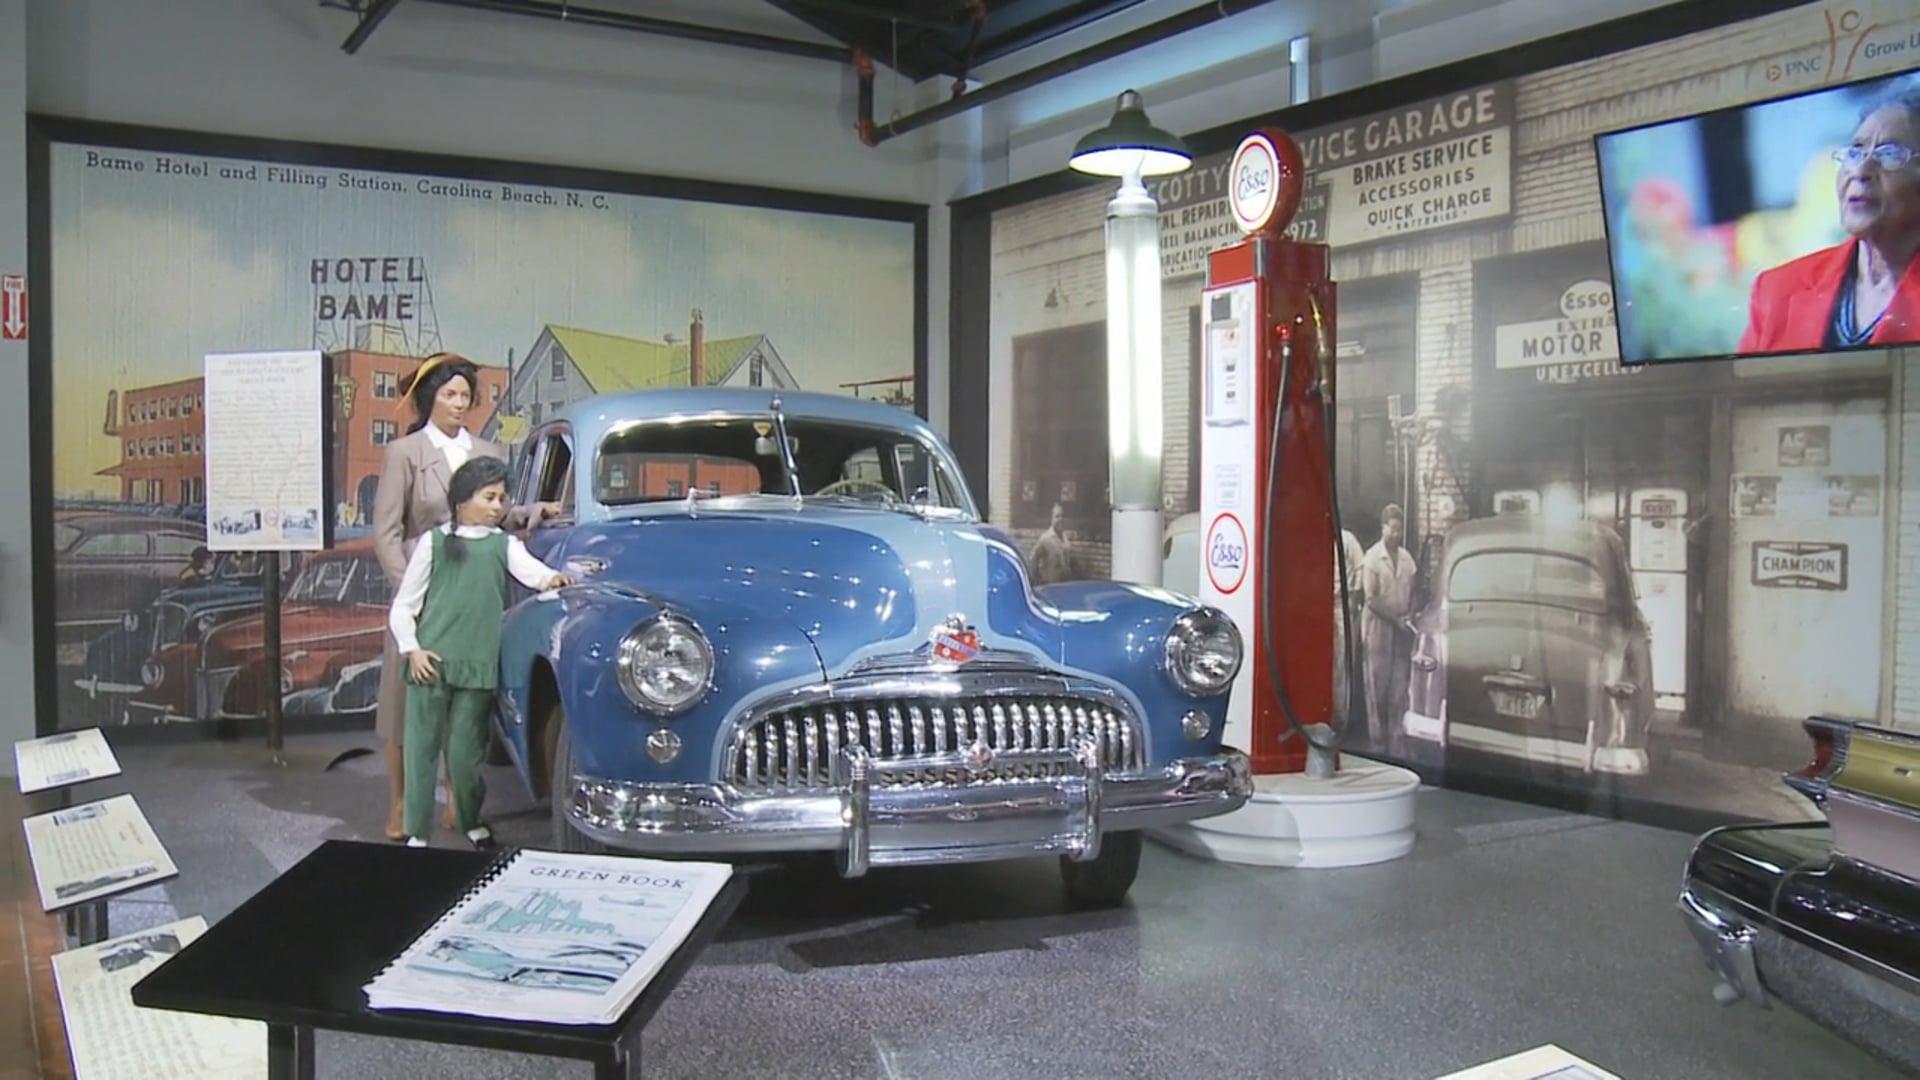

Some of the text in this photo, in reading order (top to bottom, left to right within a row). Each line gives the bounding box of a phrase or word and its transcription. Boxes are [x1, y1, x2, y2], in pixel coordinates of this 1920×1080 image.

[1865, 32, 1920, 59] Grow U
[1785, 56, 1822, 77] PNC
[1299, 127, 1357, 167] VICE
[1364, 89, 1496, 151] GARAGE
[1353, 155, 1406, 186] BRAKE
[1412, 135, 1493, 172] SERVICE
[87, 151, 144, 173] Bame
[155, 157, 208, 177] Hotel
[219, 166, 257, 181] and
[267, 167, 328, 189] Filling
[416, 178, 493, 200] Carolina
[566, 192, 583, 208] N.
[592, 195, 609, 210] C.
[1238, 165, 1269, 201] Esso
[1359, 166, 1475, 207] ACCESSORIES
[1182, 199, 1232, 227] REPAIRI
[1367, 187, 1492, 226] QUICK CHARGE
[1184, 222, 1238, 244] BALANCIN
[311, 256, 423, 283] HOTEL
[318, 294, 413, 321] BAME
[1523, 331, 1602, 359] MOTOR
[1211, 532, 1243, 569] Esso
[1762, 556, 1836, 574] CHAMPION
[530, 866, 610, 881] GREEN
[618, 874, 687, 889] BOOK
